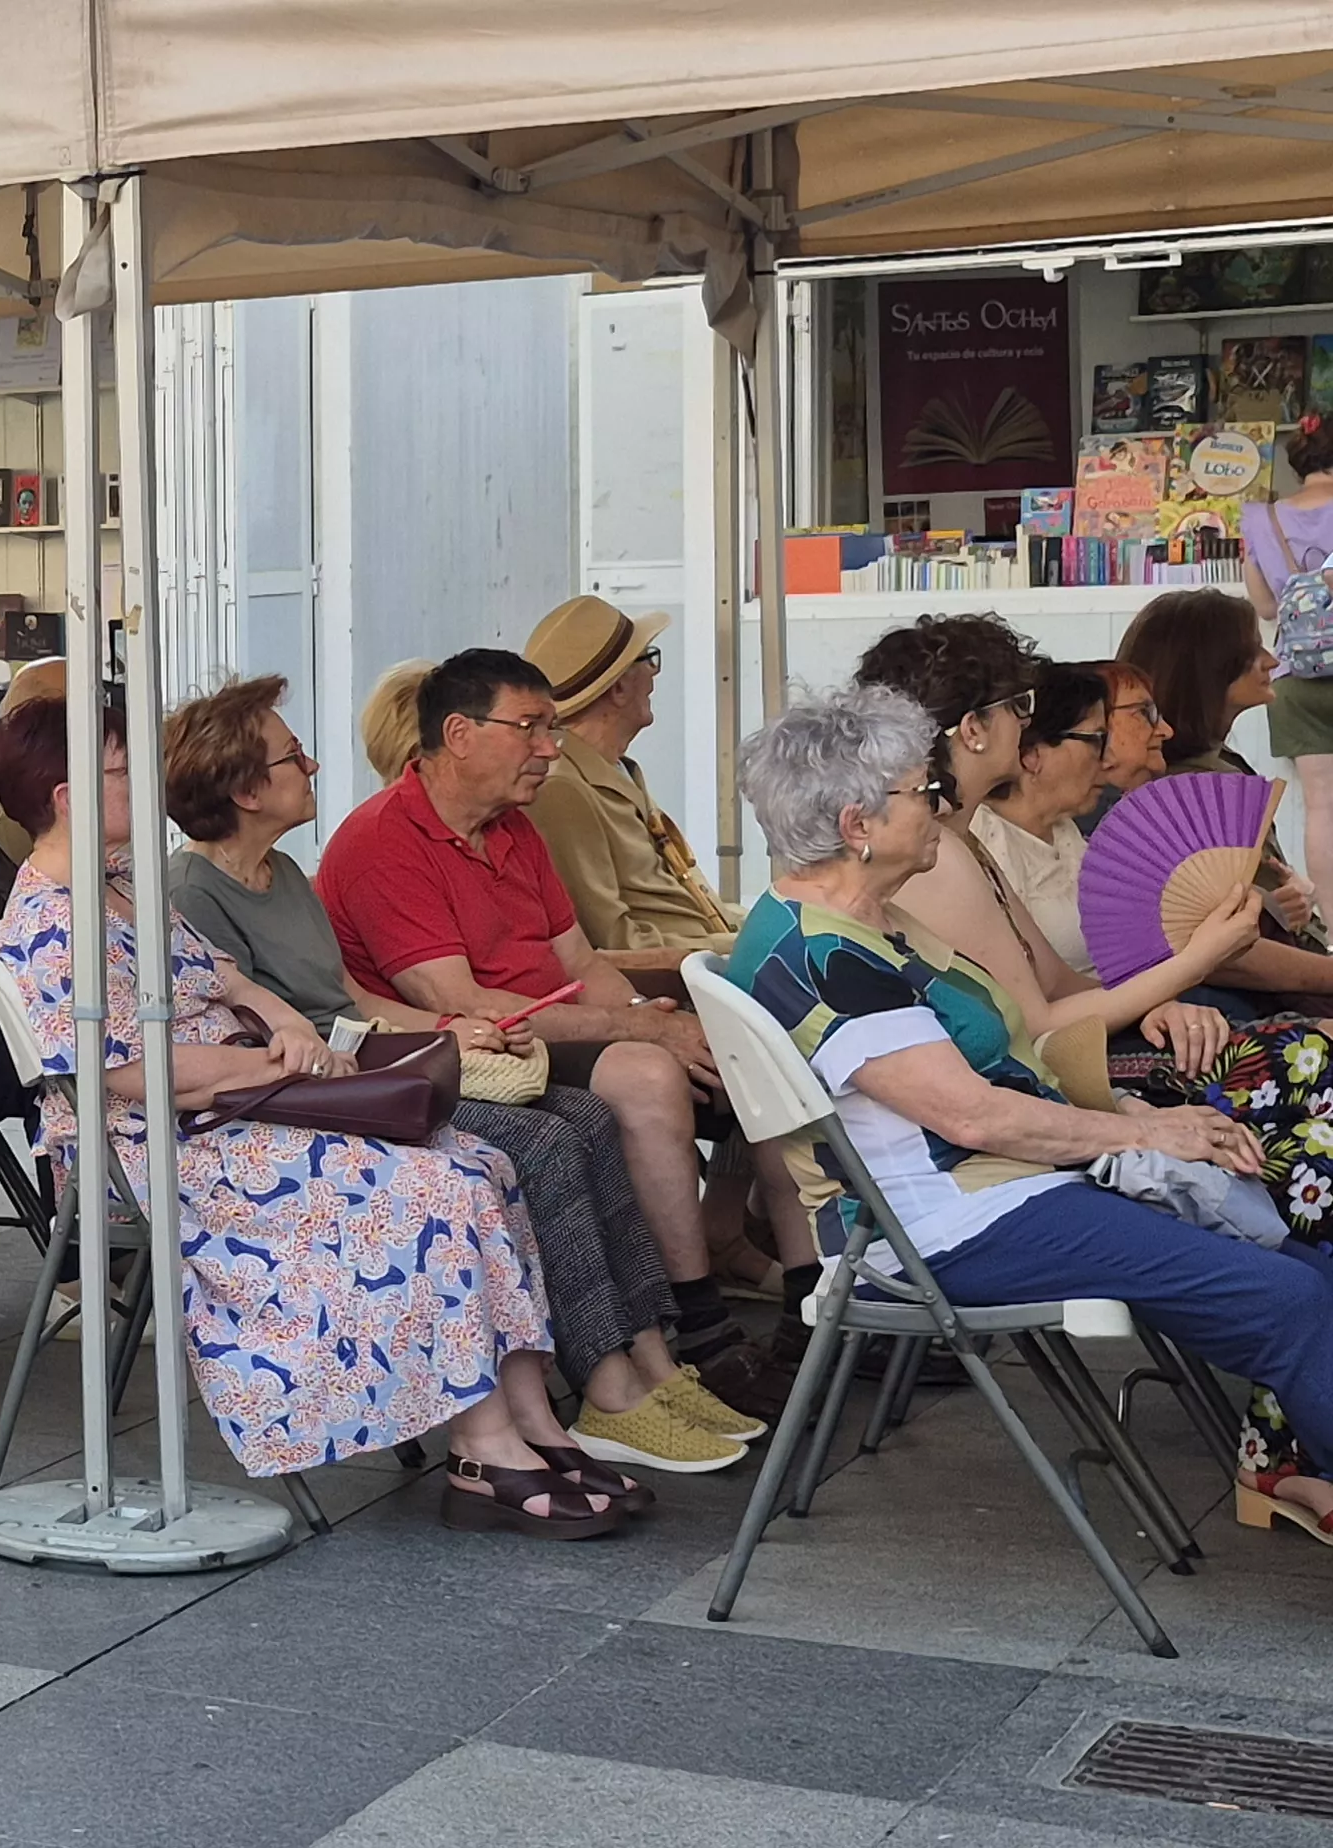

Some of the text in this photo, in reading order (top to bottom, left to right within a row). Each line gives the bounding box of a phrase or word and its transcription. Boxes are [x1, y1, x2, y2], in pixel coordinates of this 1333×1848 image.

[891, 299, 1058, 337] SANTOS OCHOA
[907, 351, 920, 361] Tu
[921, 350, 961, 362] espacio
[962, 348, 976, 359] de
[977, 346, 1014, 359] cultura
[1023, 345, 1045, 357] ocio
